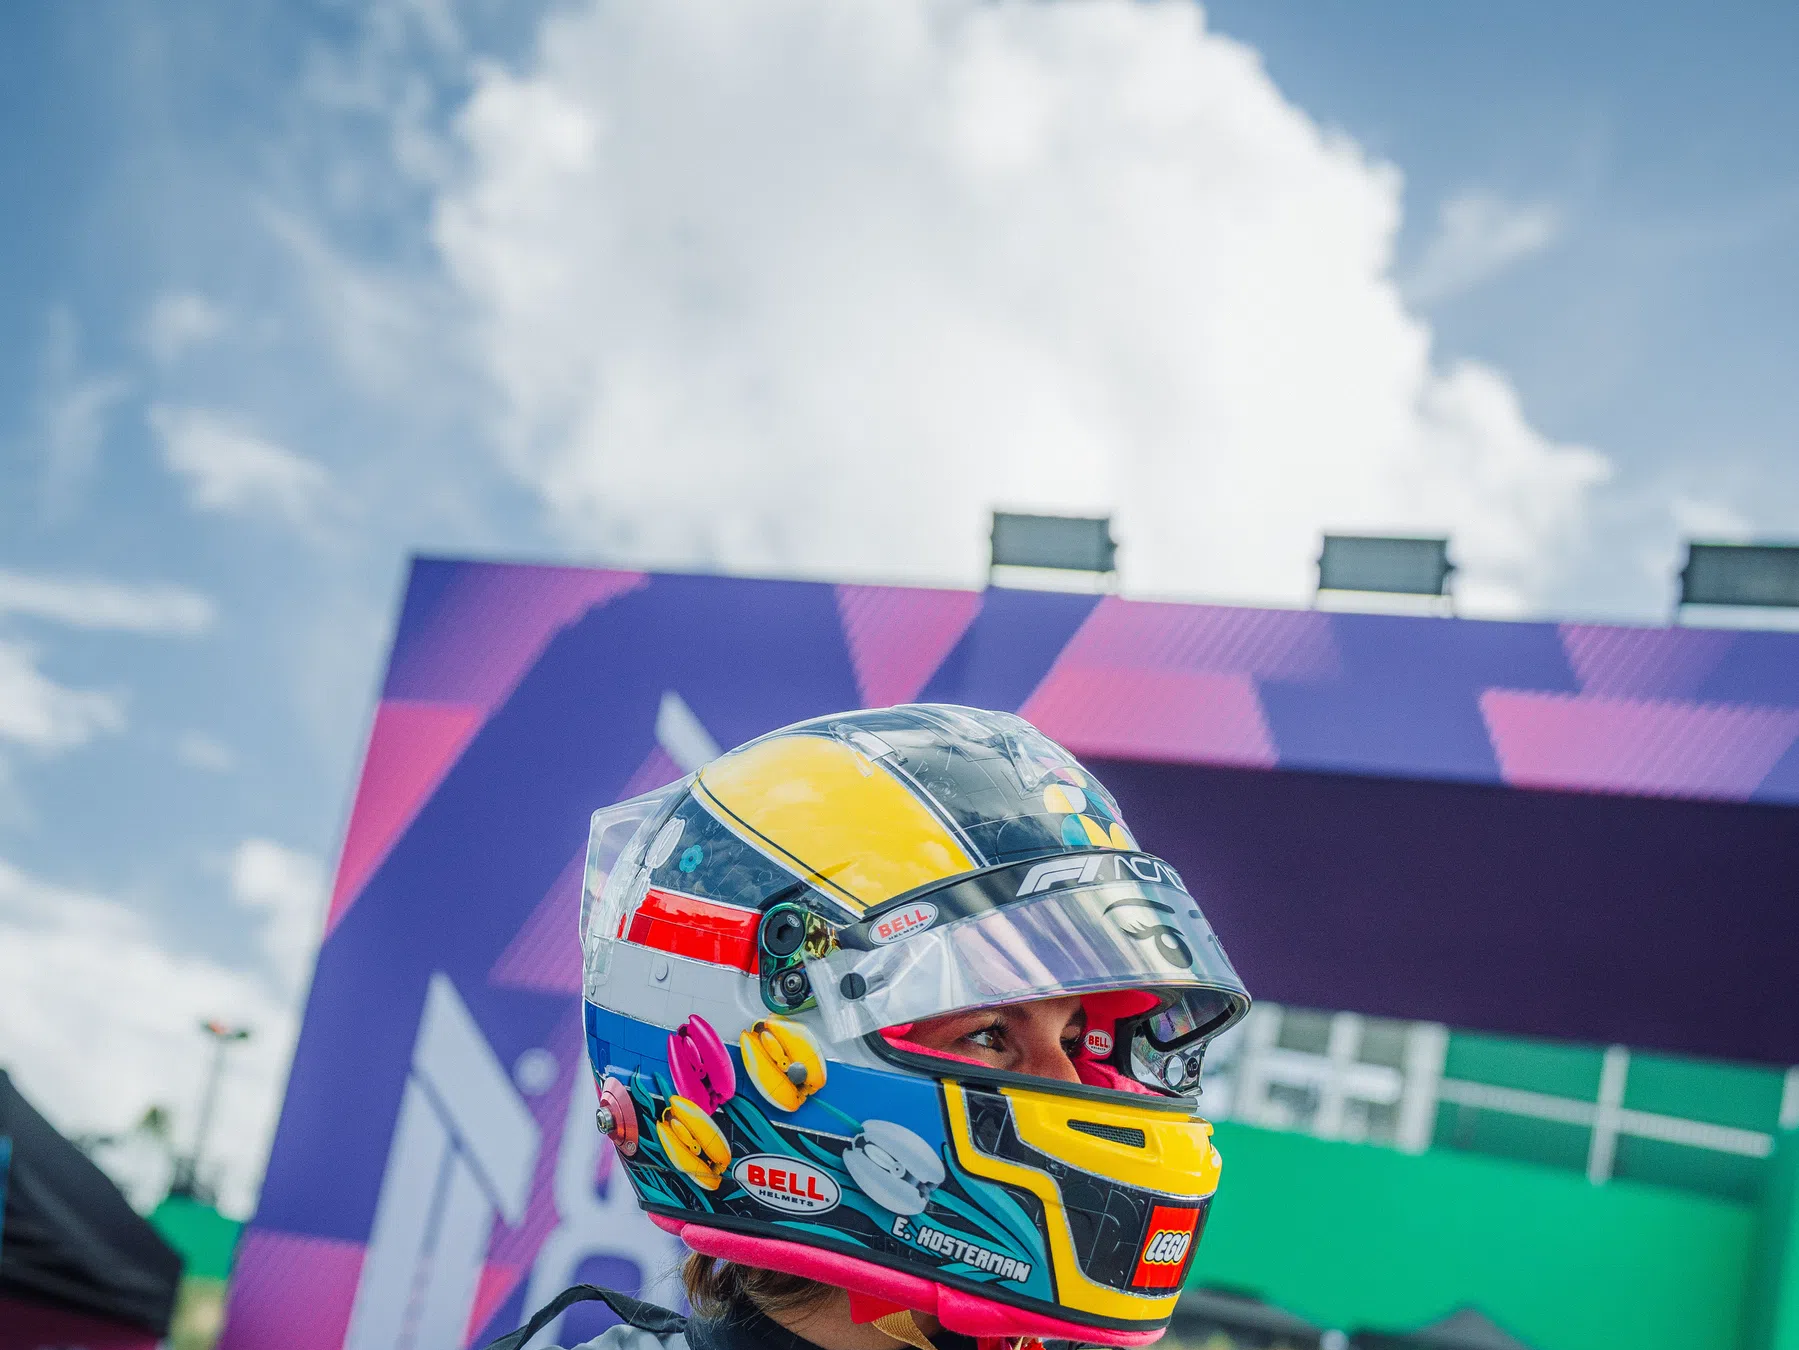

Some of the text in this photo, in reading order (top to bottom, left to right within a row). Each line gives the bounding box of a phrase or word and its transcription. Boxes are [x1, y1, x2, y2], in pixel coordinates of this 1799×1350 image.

[878, 909, 928, 938] BELL
[1088, 1035, 1109, 1048] BELL
[747, 1163, 824, 1201] BELL
[759, 1189, 814, 1207] HELMETS
[891, 1216, 1031, 1282] E. KOSTERMAN
[1144, 1230, 1191, 1264] LEGO
